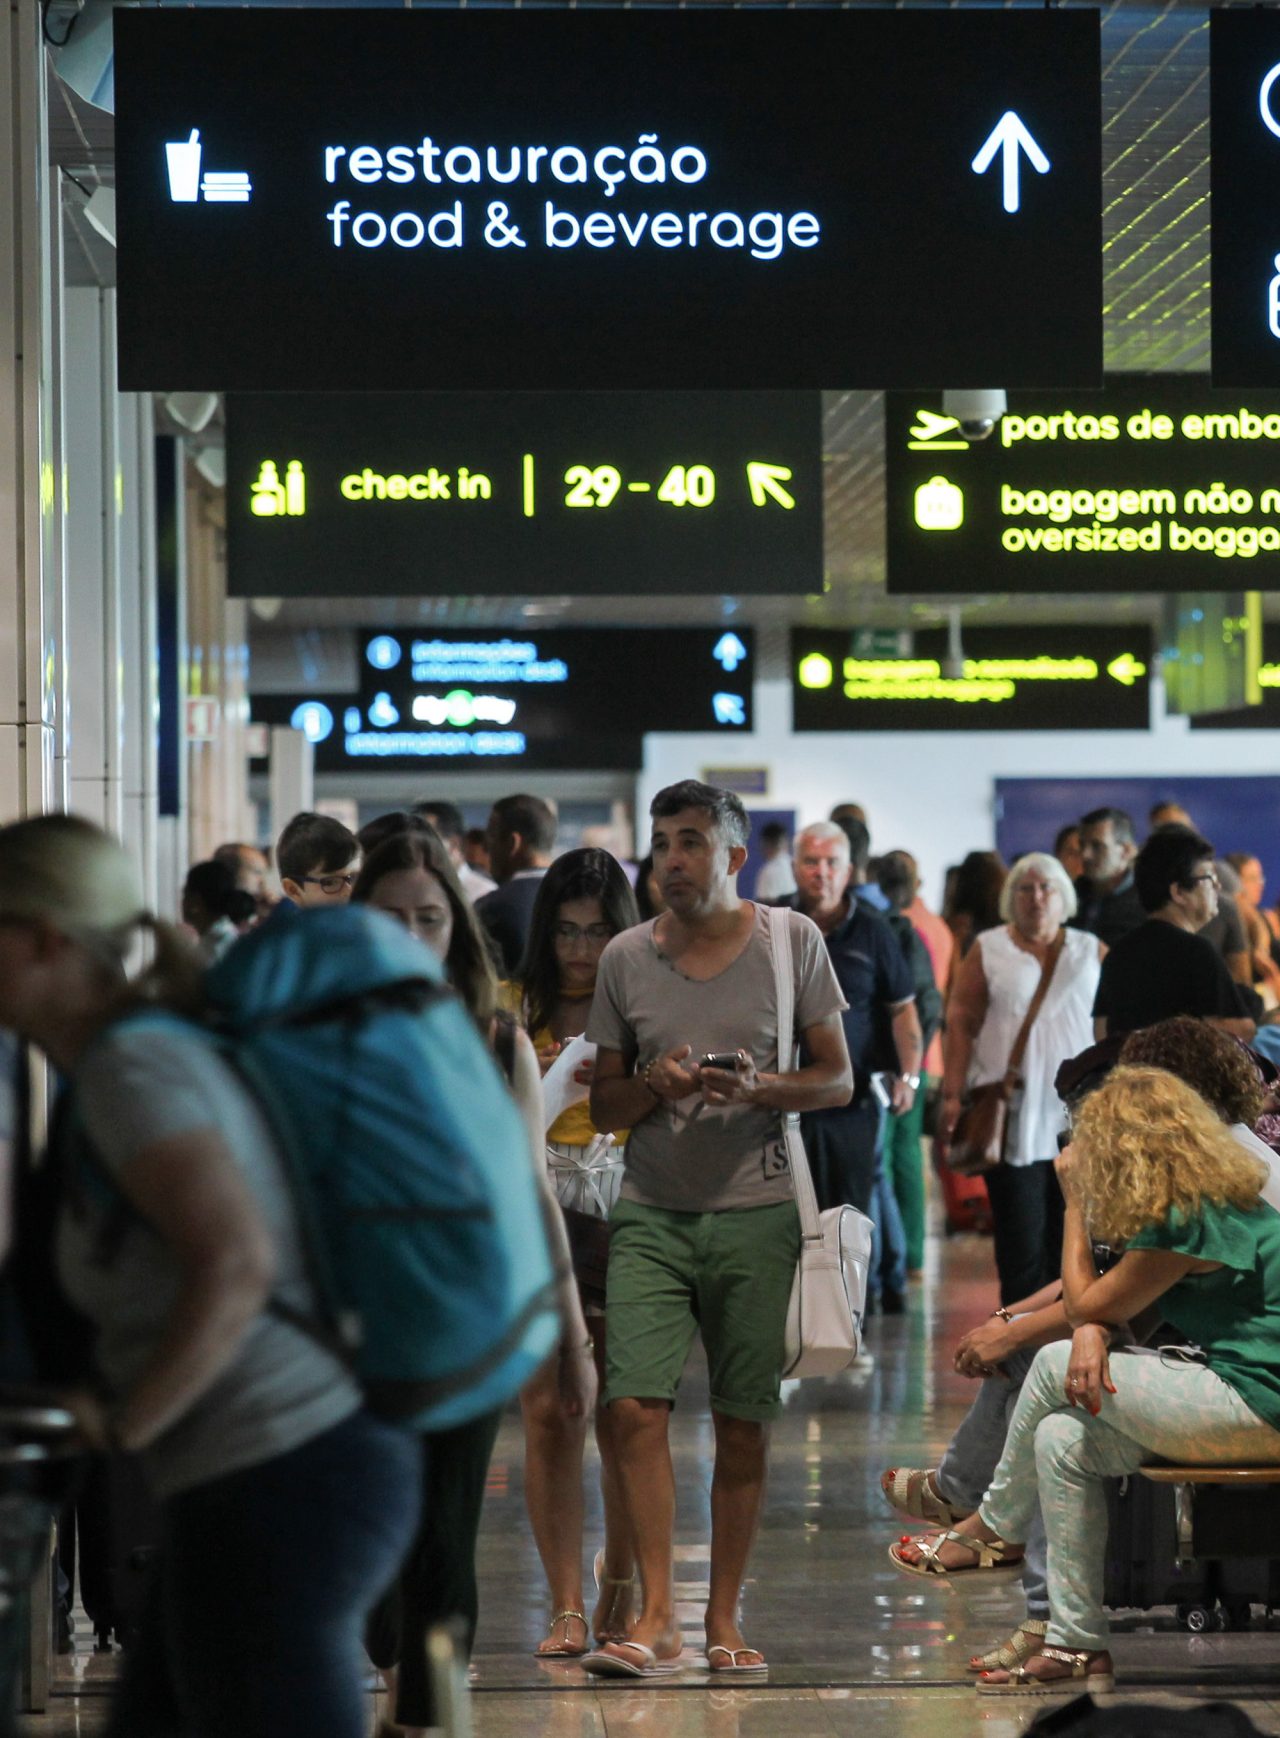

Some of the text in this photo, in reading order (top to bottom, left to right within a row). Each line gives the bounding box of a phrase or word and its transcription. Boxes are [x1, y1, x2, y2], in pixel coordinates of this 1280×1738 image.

[325, 133, 707, 195] restauração
[326, 200, 820, 260] food & beverage
[1001, 410, 1120, 446] portas
[1127, 409, 1174, 440] de
[341, 467, 491, 500] check in
[1001, 483, 1176, 519] bagagem
[1184, 482, 1253, 514] não
[1002, 521, 1161, 553] oversized
